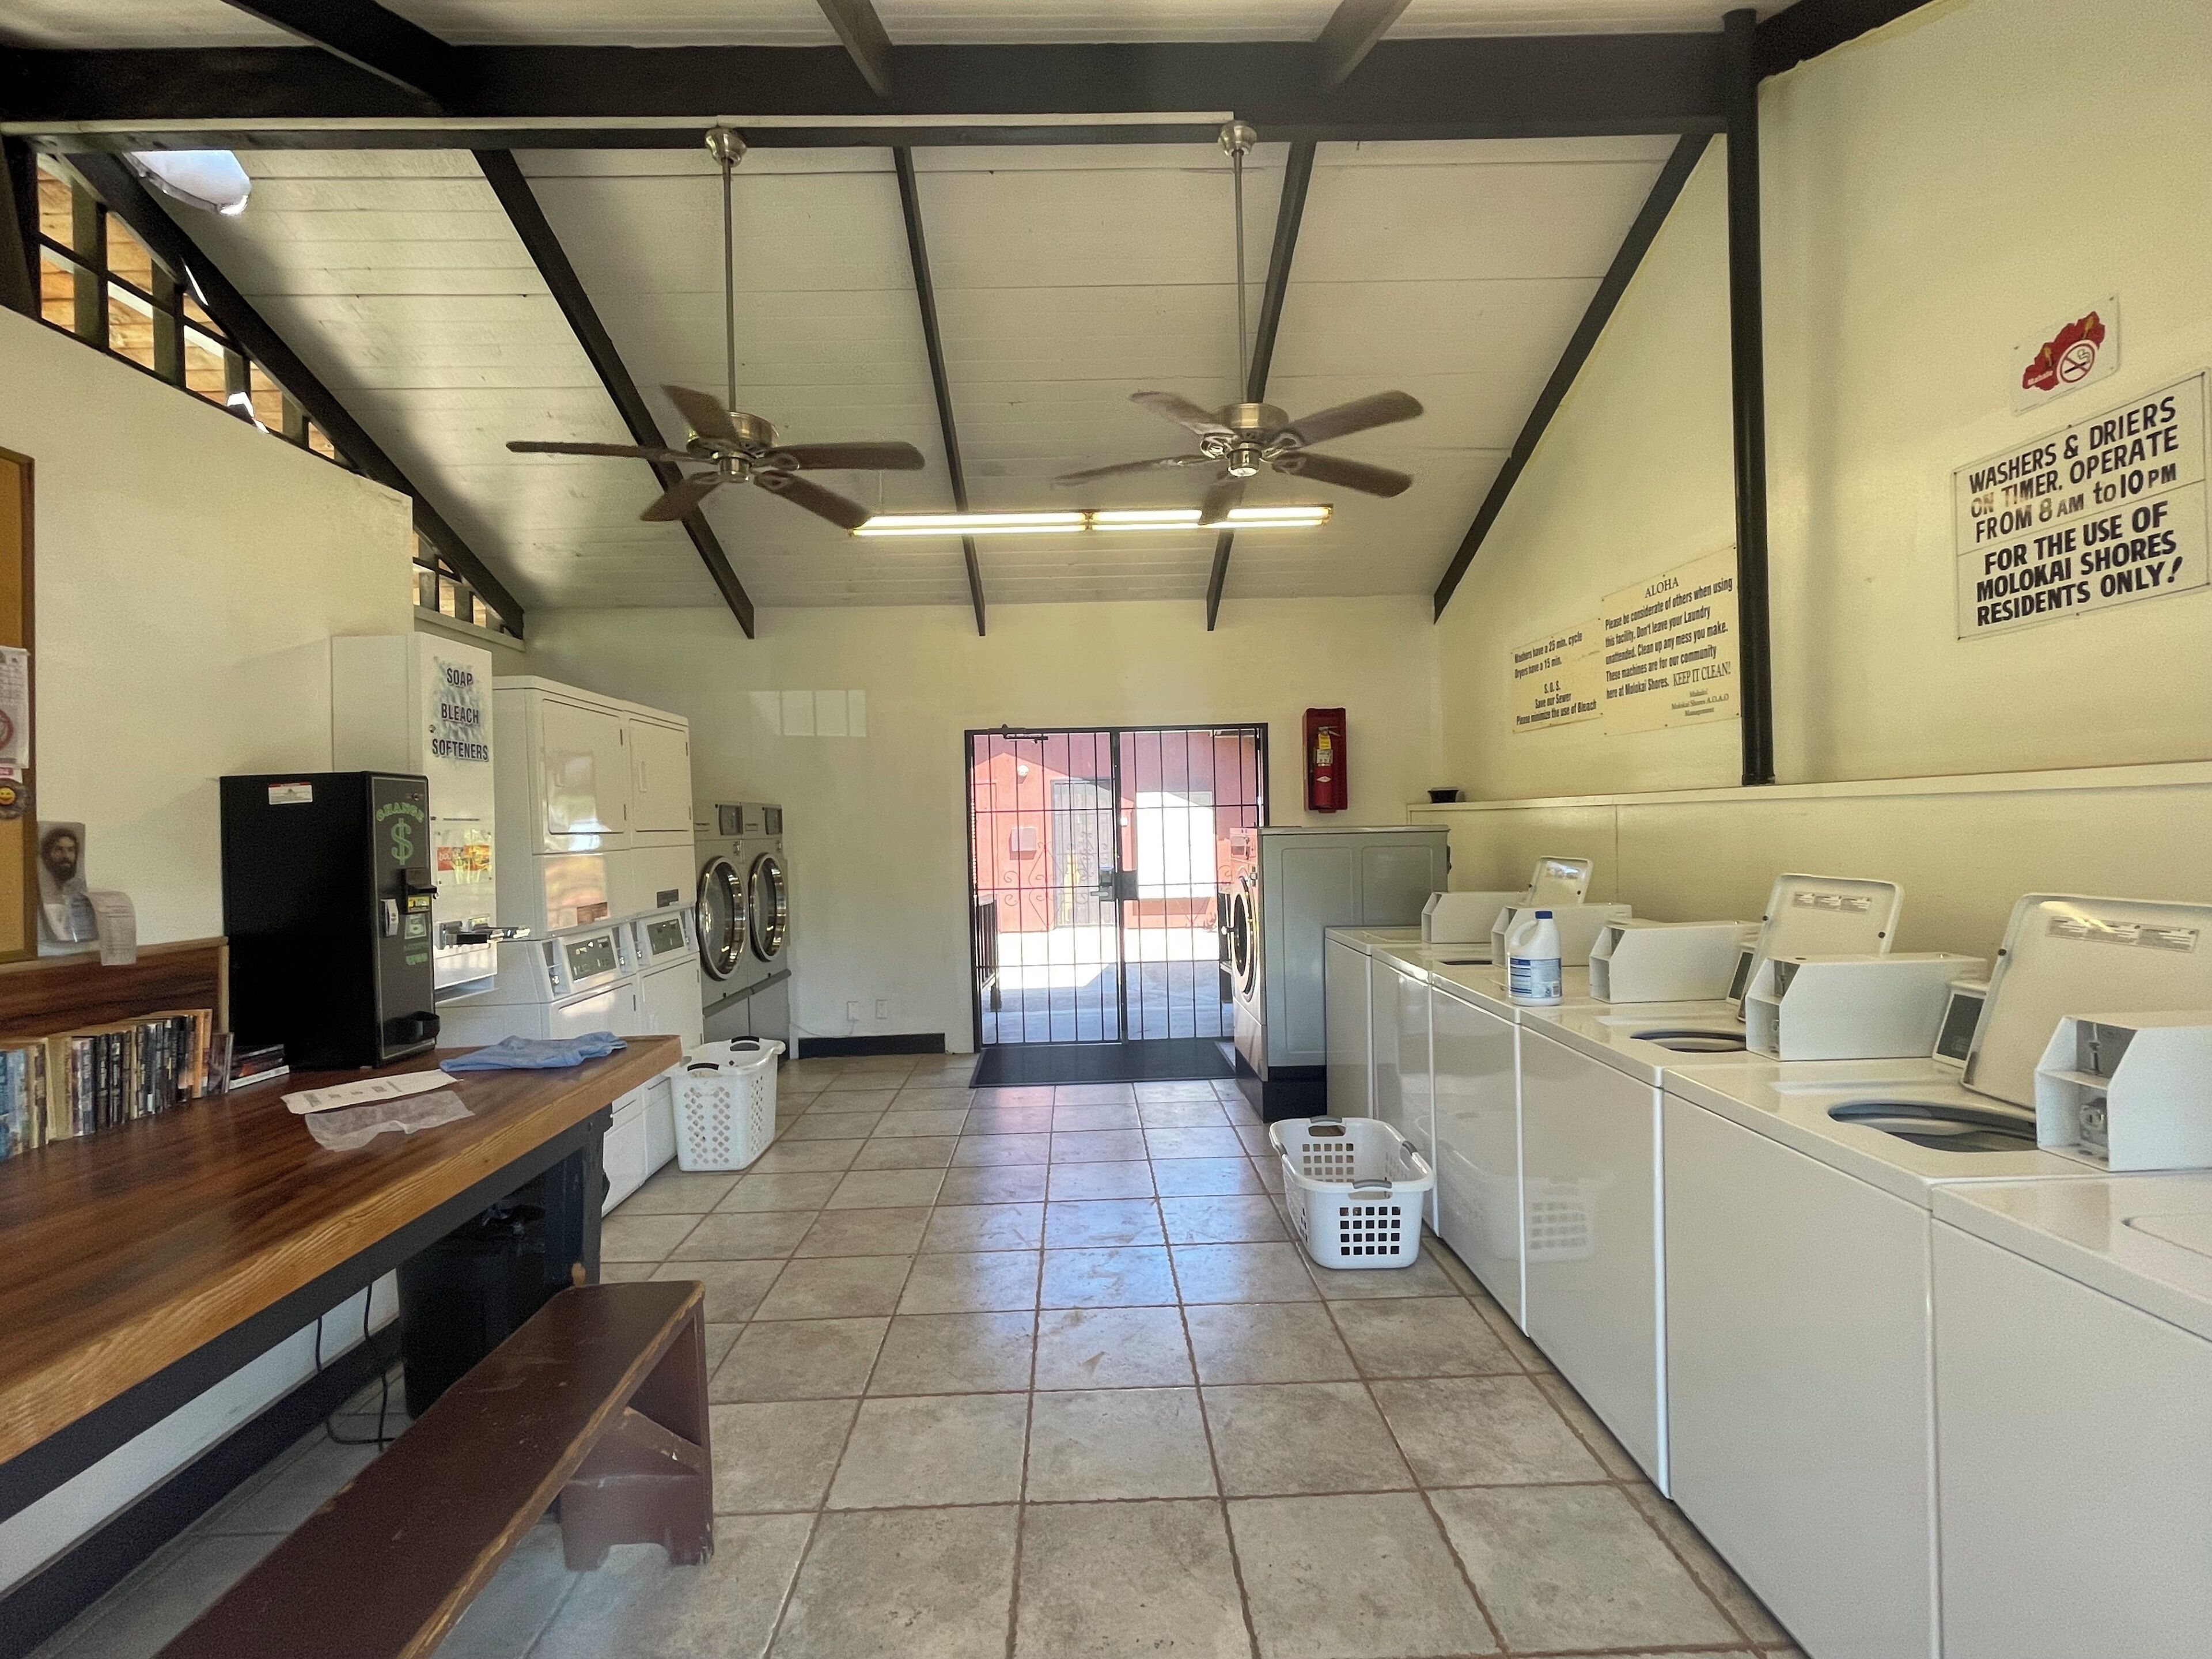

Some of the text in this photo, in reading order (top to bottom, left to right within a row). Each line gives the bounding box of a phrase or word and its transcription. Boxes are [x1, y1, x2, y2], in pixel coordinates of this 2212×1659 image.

[1969, 396, 2176, 494] WASHERS & DRIERS
[1971, 425, 2179, 518] ON TIMER. OPERATE
[1976, 505, 2032, 543] FROM
[2093, 481, 2116, 504] to
[1984, 501, 2168, 575] FOR THE USE OF
[1977, 529, 2176, 602] MOLOKAI SHORES
[1605, 577, 1733, 630] Please be considerate of others when using
[1645, 577, 1679, 598] ALOHA
[1978, 556, 2183, 626] RESIDENTS ONLY!
[1605, 635, 1615, 647] this
[1637, 623, 1651, 638] Don't
[1652, 619, 1668, 633] leave
[1669, 615, 1683, 630] your
[1684, 605, 1710, 623] Laundry
[1638, 643, 1653, 656] Clean
[1655, 640, 1662, 653] up
[1664, 637, 1674, 650] any
[1676, 632, 1692, 645] mess
[1694, 627, 1705, 643] you
[1707, 621, 1728, 637] make.
[1514, 650, 1532, 663] Washers
[1533, 646, 1543, 657] have
[1549, 640, 1555, 652] 25
[1568, 631, 1582, 646] cycle
[1606, 645, 1717, 681] These machines are for our community
[446, 668, 474, 687] SOAP
[1515, 667, 1528, 679] Dryers
[1529, 662, 1539, 674] have
[1540, 662, 1543, 671] a
[1544, 658, 1550, 669] 15
[1607, 661, 1730, 699] here at Molokai Shores. KEEP IT CLEAN!
[441, 703, 479, 724] BLEACH
[1517, 715, 1530, 725] Please
[1560, 707, 1570, 716] use
[1571, 703, 1576, 714] of
[1577, 699, 1597, 713] Bleach
[1535, 699, 1546, 709] Save
[1556, 694, 1571, 704] Sewer
[432, 738, 489, 761] SOFTENERS
[376, 802, 425, 823] CHANGE
